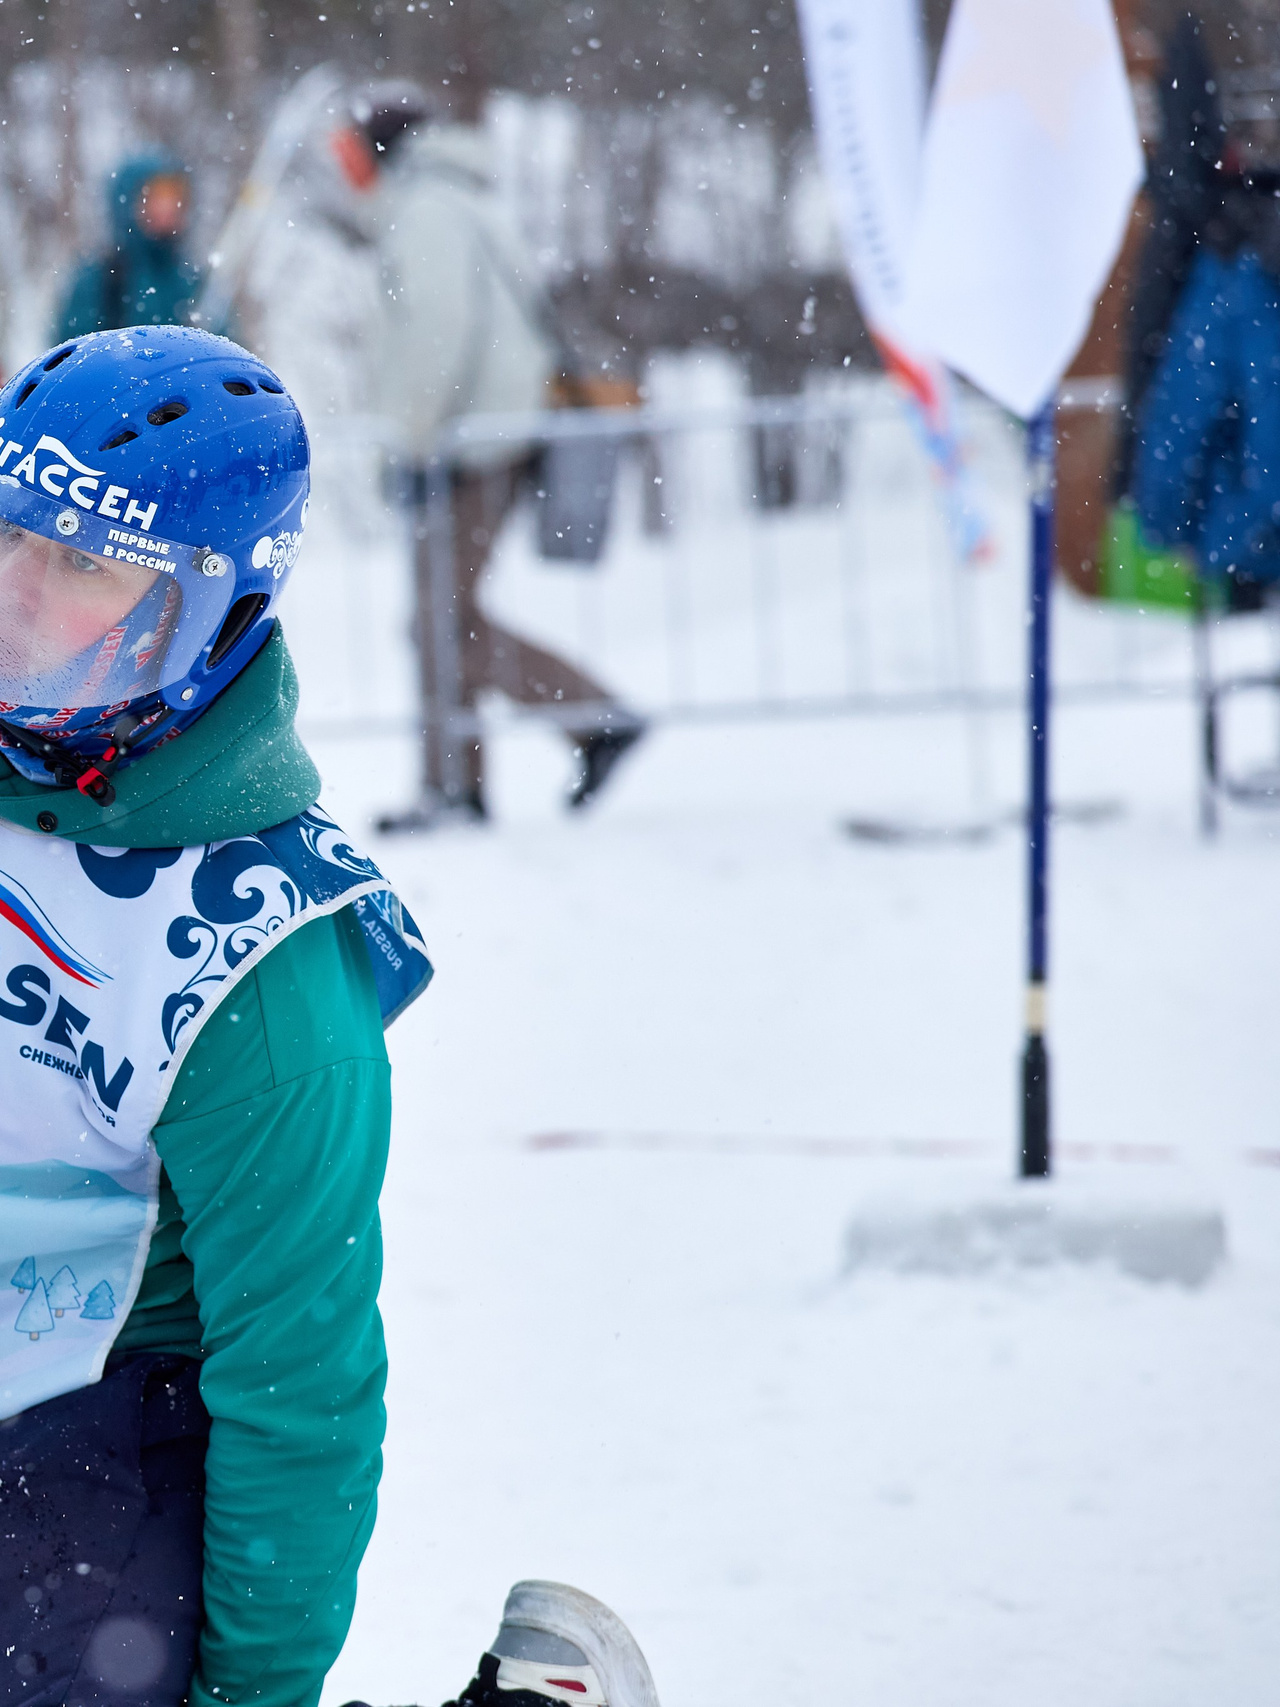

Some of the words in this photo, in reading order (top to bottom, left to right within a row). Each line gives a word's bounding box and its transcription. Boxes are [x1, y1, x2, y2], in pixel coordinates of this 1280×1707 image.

[107, 528, 171, 555] ПЕРВЫЕ
[102, 544, 115, 557] В
[115, 548, 177, 574] РОССИИ
